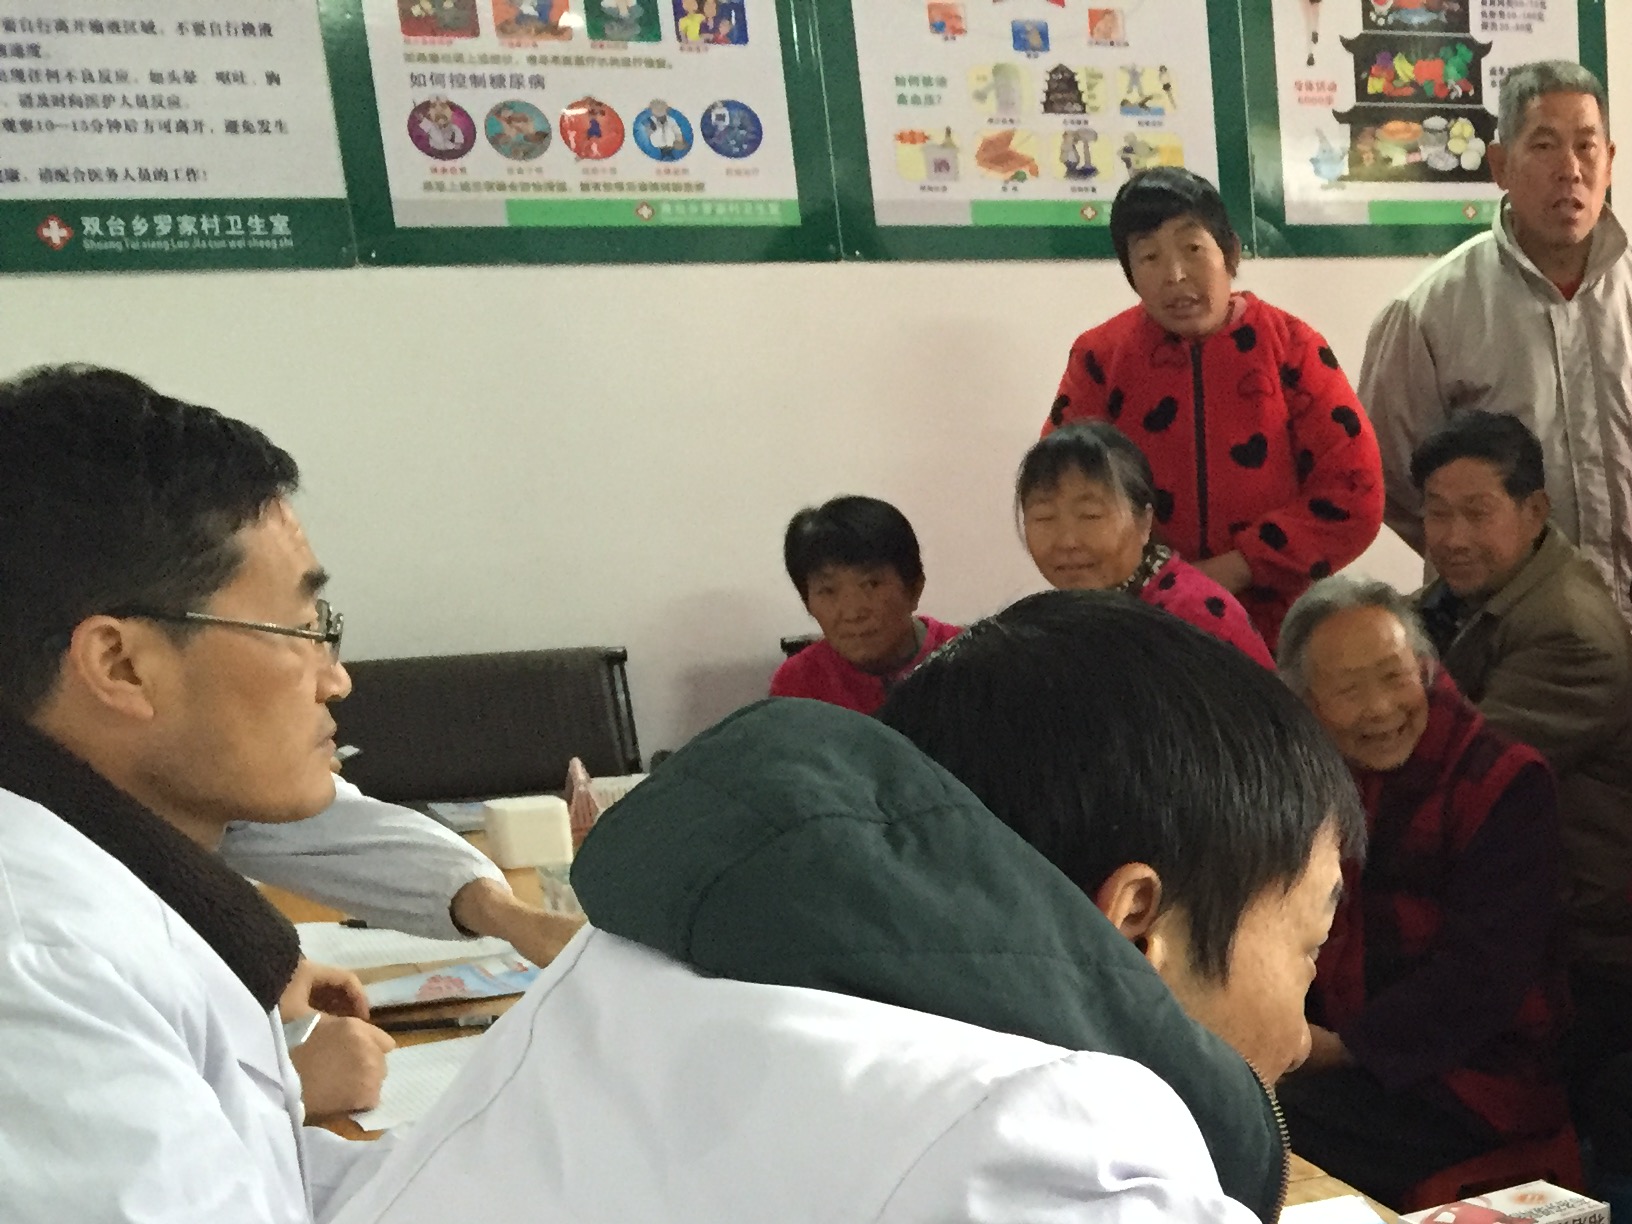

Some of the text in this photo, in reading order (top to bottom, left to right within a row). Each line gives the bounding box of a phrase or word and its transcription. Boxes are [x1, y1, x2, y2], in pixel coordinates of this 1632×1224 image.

[409, 71, 547, 92] 如何控制糖尿病
[80, 213, 291, 237] 双台乡罗家村卫生室
